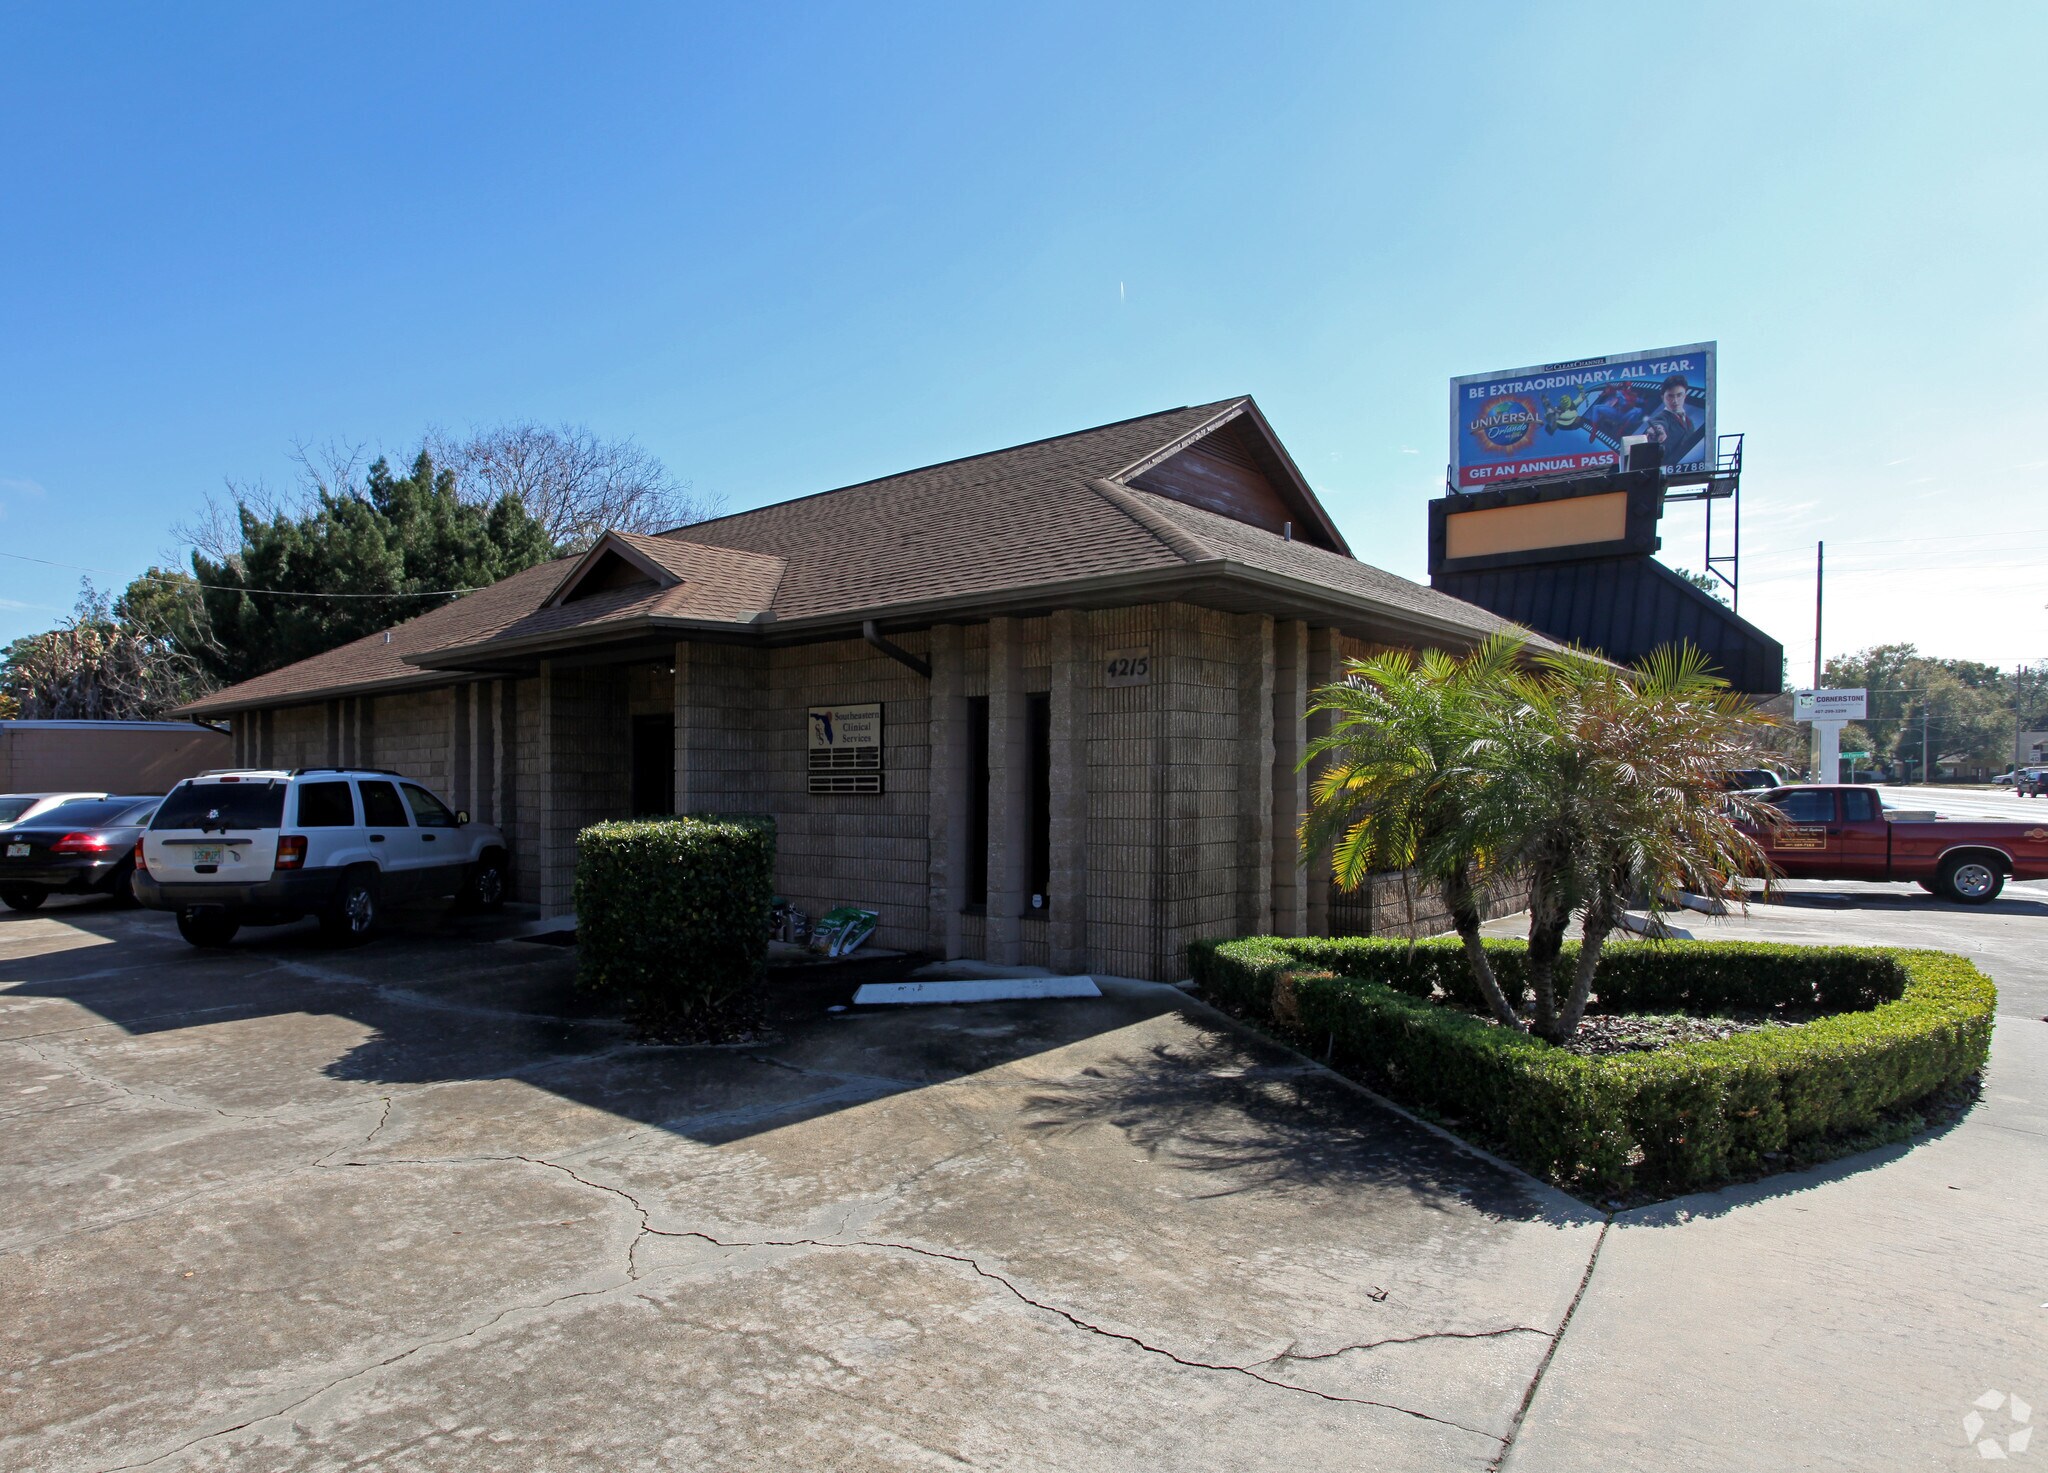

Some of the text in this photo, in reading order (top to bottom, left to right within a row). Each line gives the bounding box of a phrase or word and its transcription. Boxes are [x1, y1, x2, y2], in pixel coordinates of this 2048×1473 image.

[1469, 359, 1695, 399] BE EXTRAORDINARY. ALL YEAR.
[1470, 412, 1542, 430] UNIVERSAL
[1487, 422, 1528, 439] Orlando
[1469, 454, 1614, 479] GET AN ANNUAL PASS
[1107, 657, 1148, 678] 4215
[835, 711, 879, 720] Southeastern
[843, 722, 871, 731] Clinical
[842, 734, 872, 743] Services
